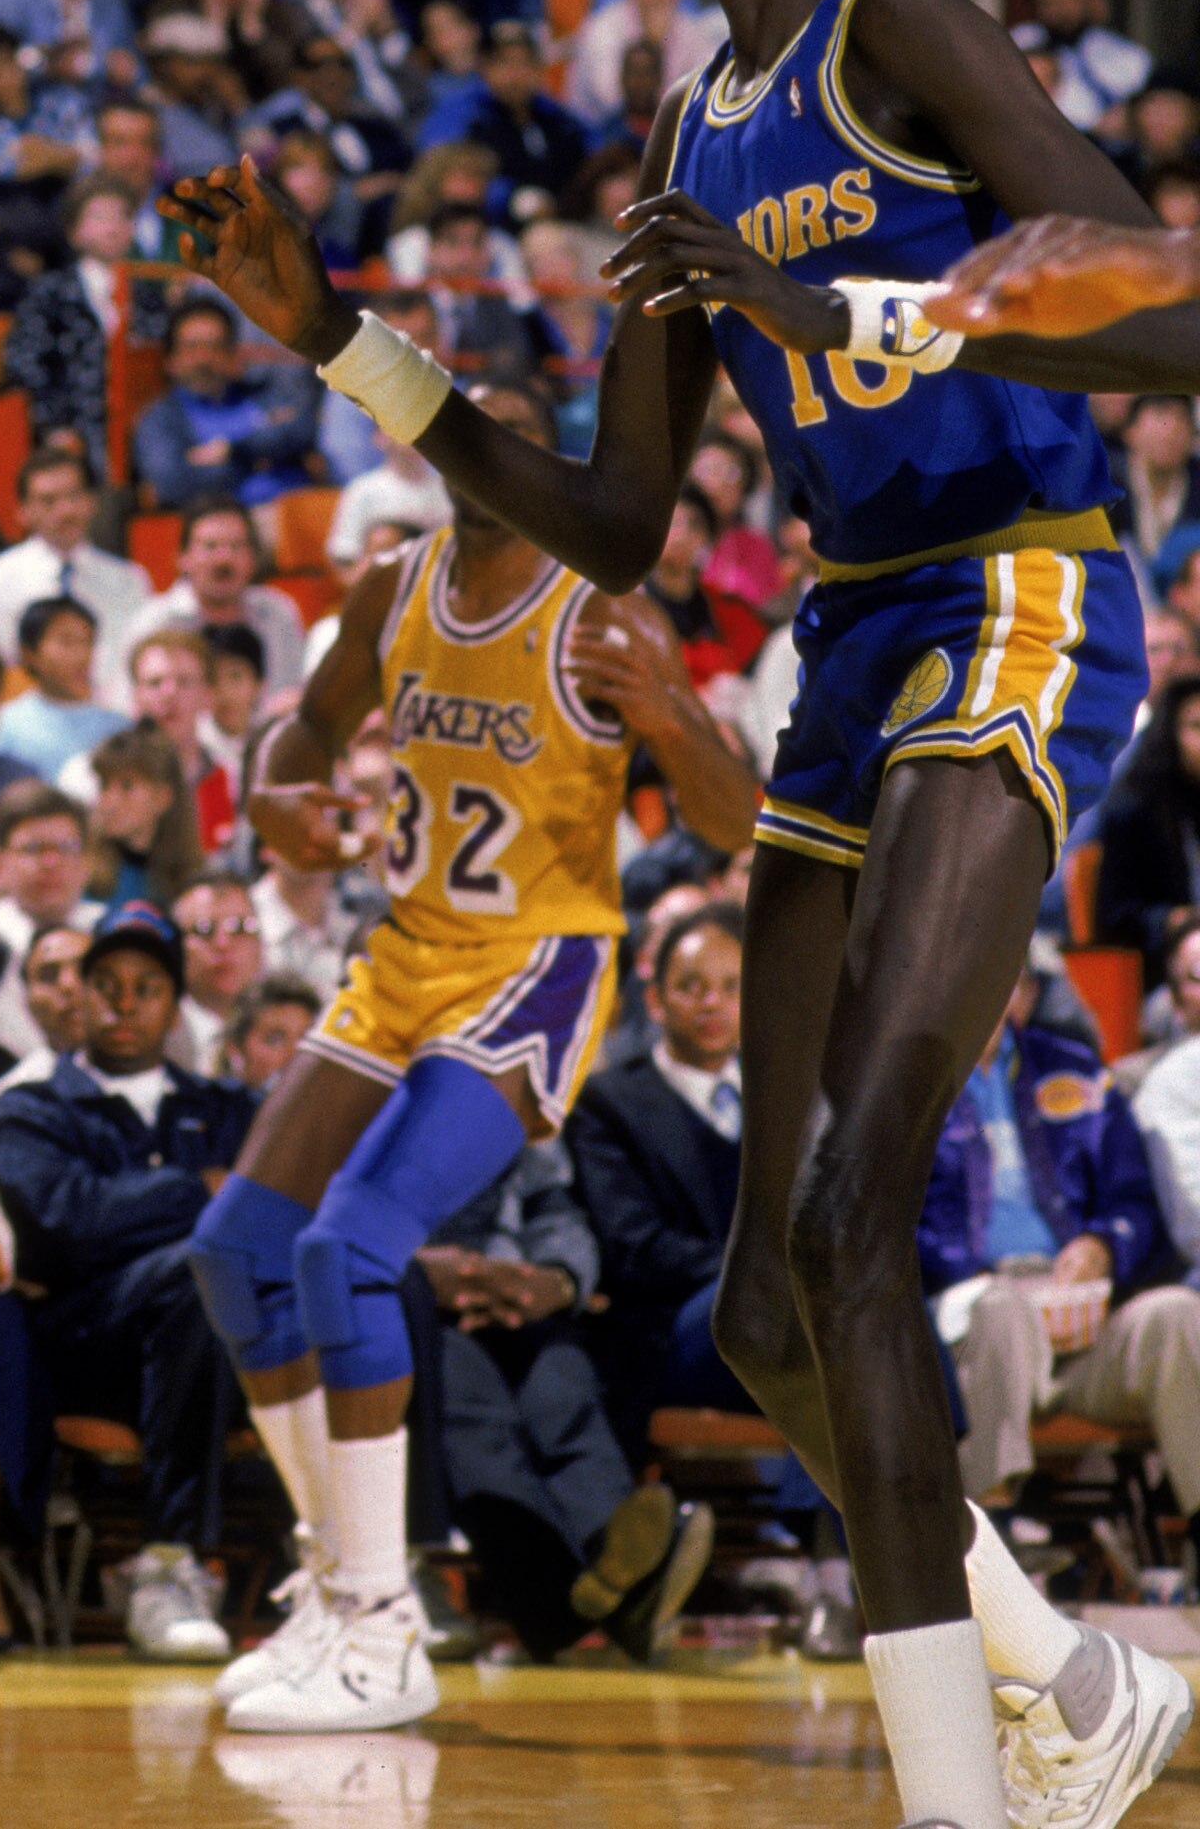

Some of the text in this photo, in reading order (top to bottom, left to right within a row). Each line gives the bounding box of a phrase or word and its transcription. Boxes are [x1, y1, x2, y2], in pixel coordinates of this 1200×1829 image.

[736, 167, 877, 268] IORS
[392, 668, 546, 768] LAKERS
[386, 760, 523, 917] 32
